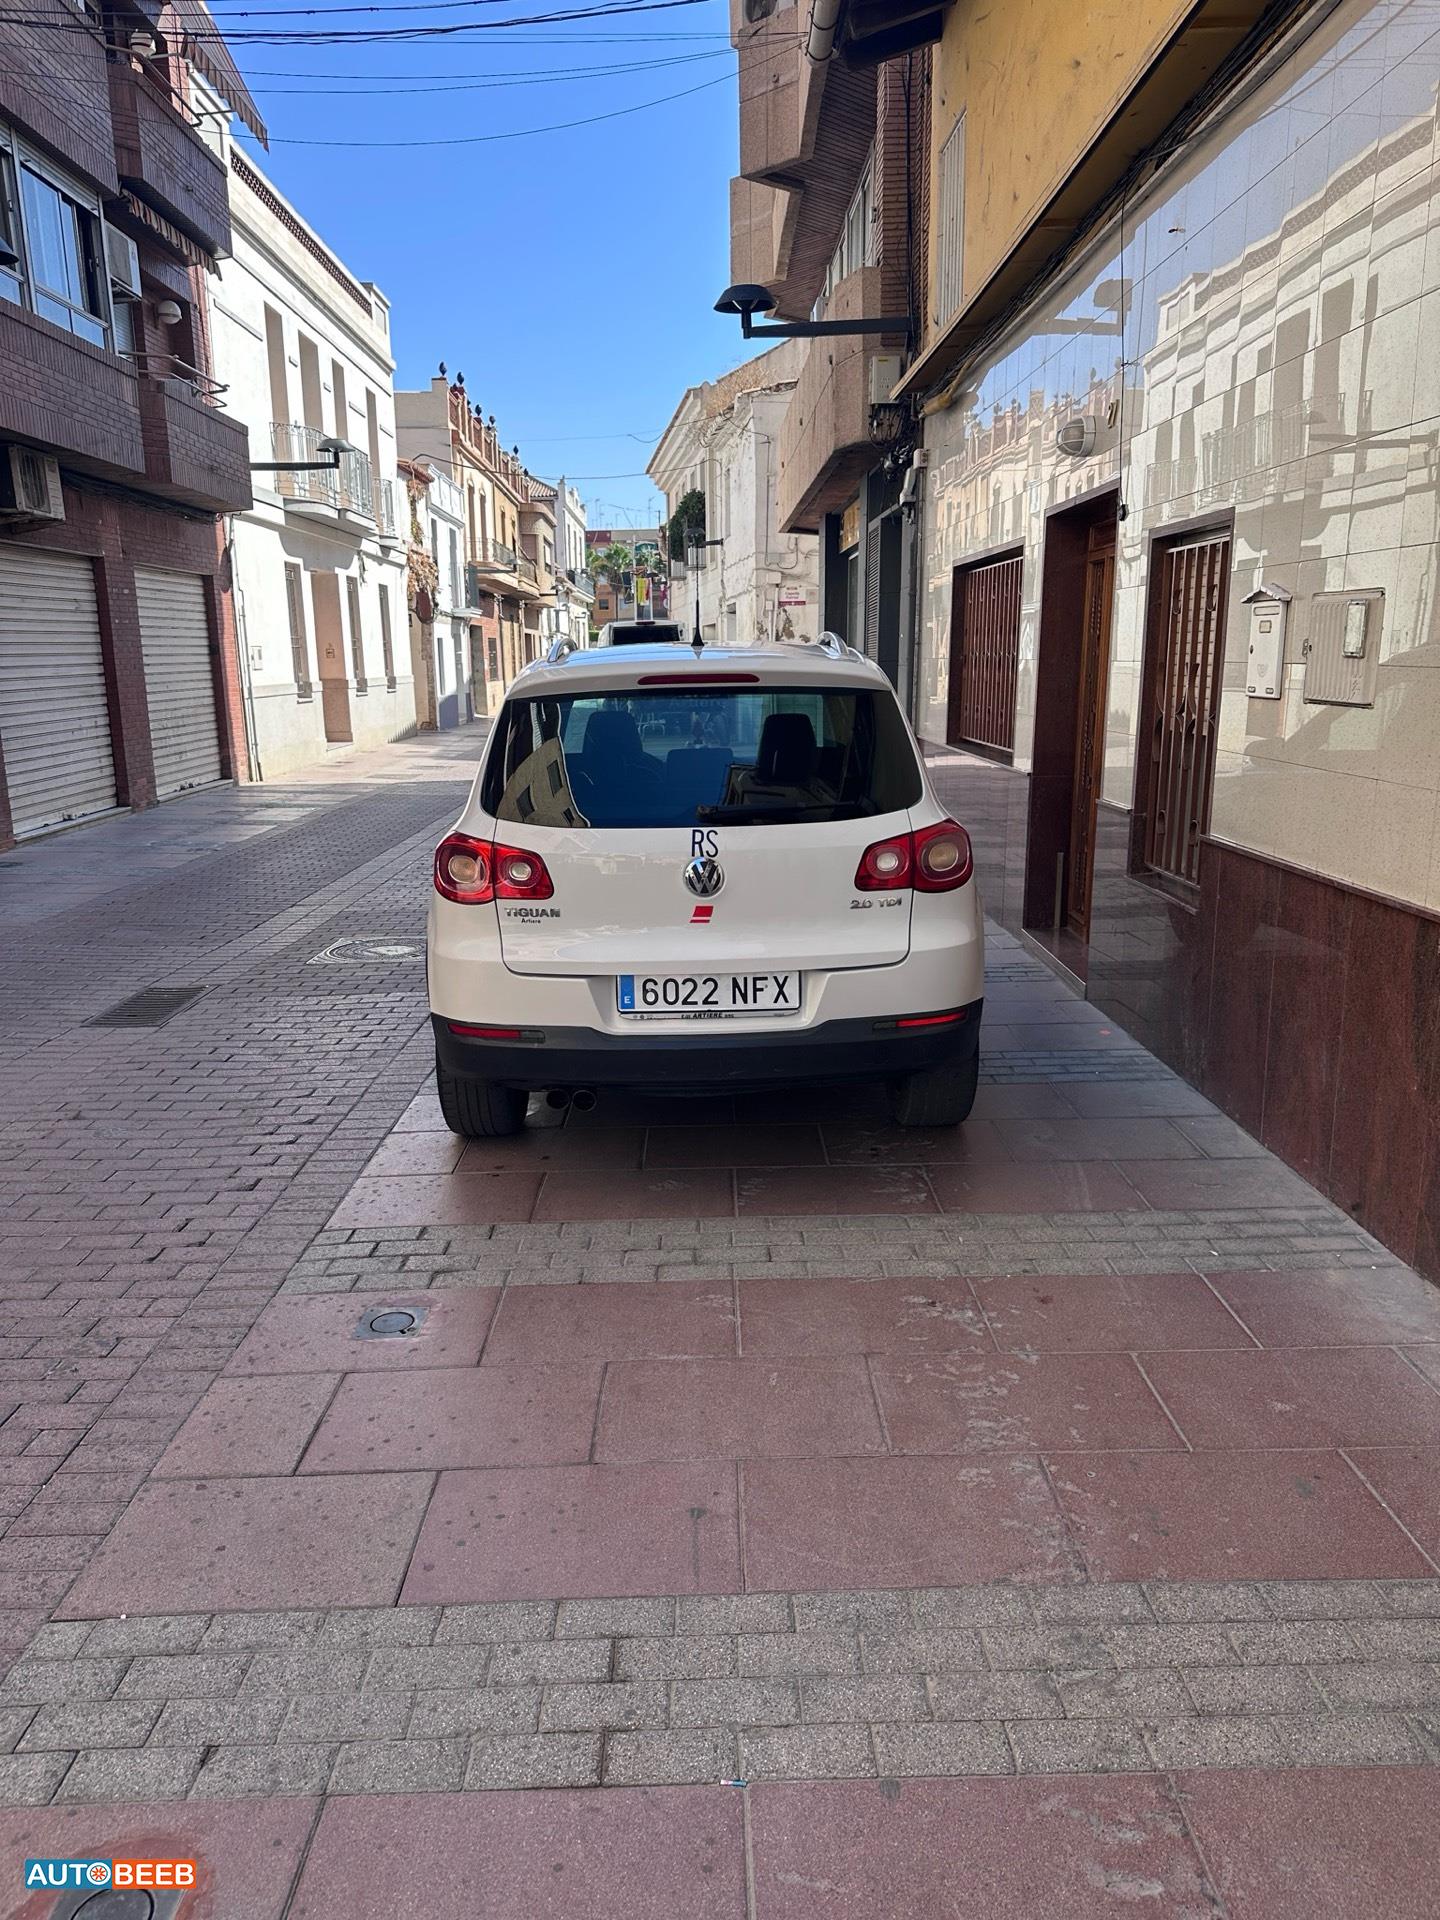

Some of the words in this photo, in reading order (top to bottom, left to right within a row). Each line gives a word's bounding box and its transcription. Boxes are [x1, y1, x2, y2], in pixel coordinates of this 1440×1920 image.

[691, 829, 719, 858] RS
[504, 907, 561, 917] TIGUAN
[624, 996, 631, 1004] E
[642, 978, 719, 1006] 6022
[731, 976, 789, 1005] NFX
